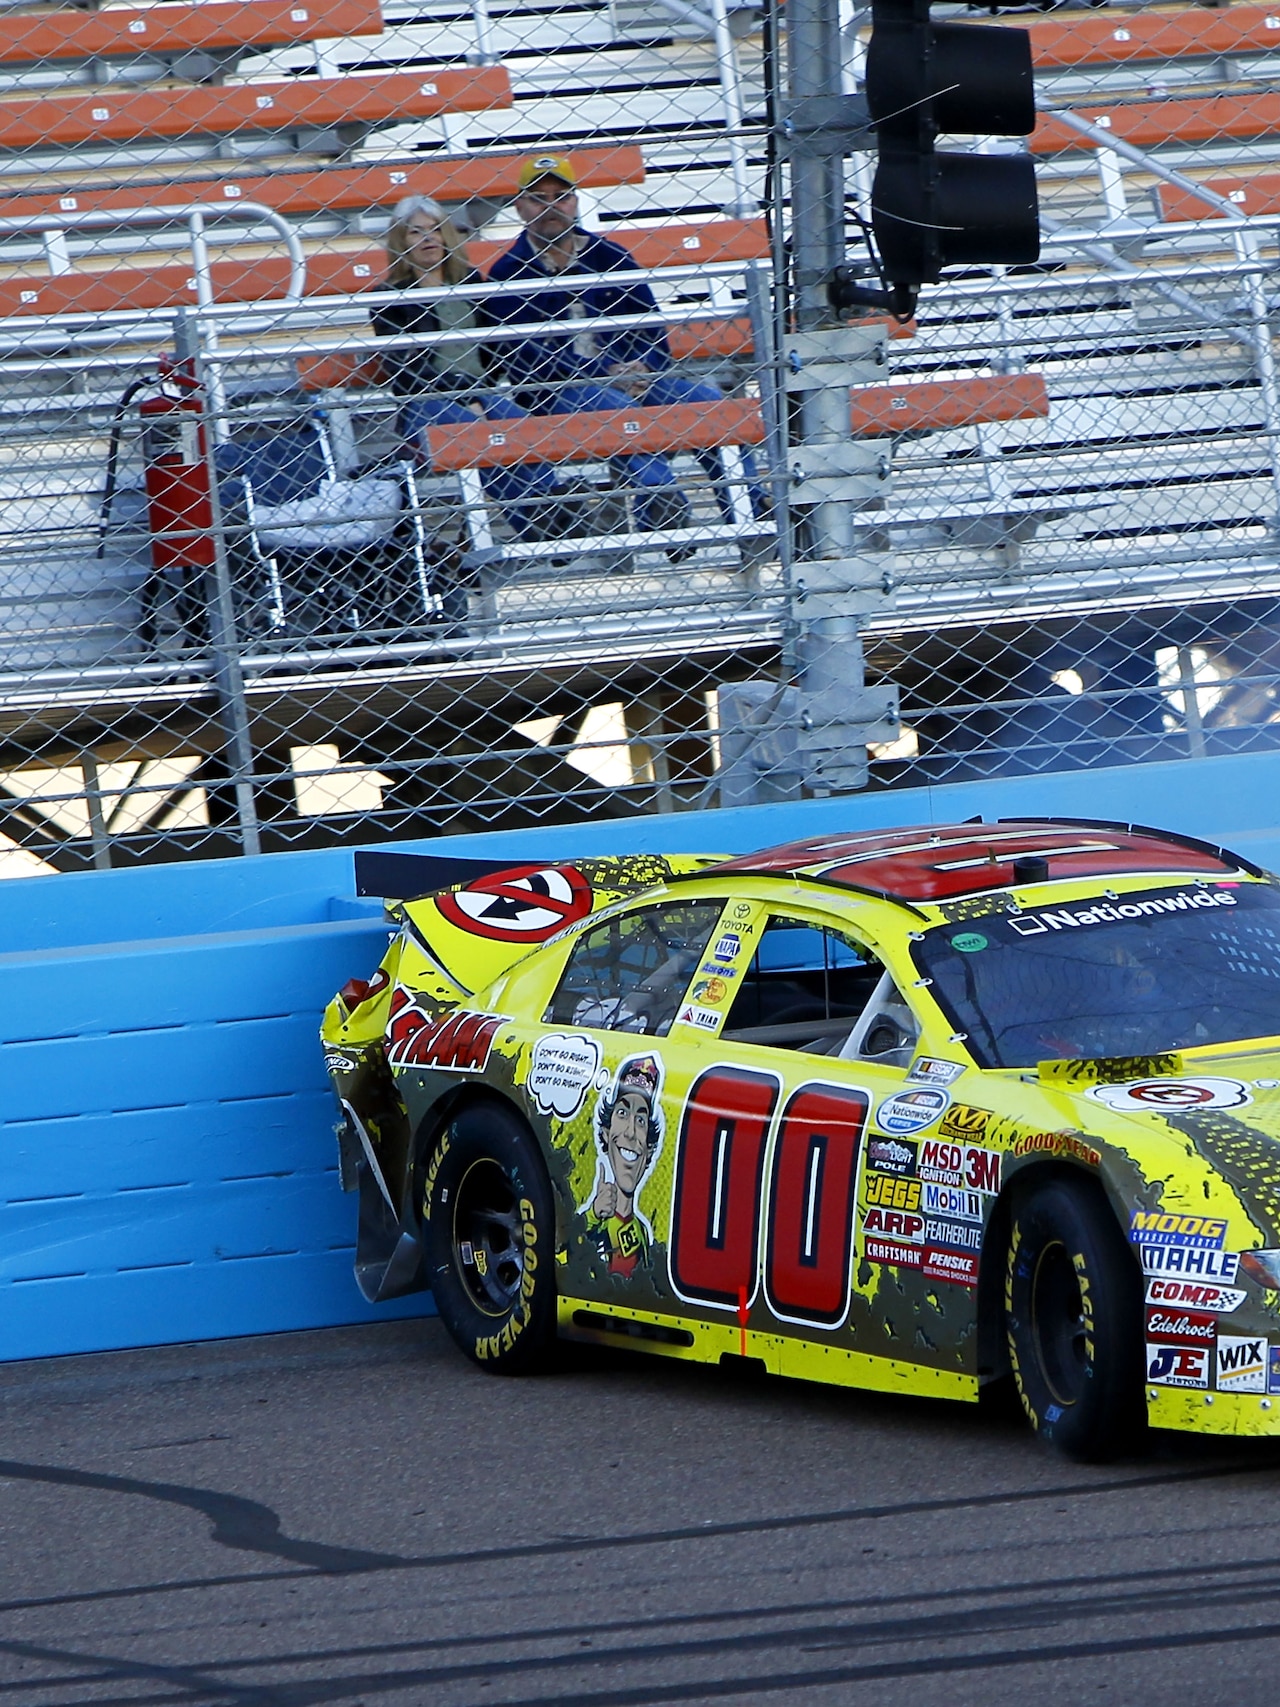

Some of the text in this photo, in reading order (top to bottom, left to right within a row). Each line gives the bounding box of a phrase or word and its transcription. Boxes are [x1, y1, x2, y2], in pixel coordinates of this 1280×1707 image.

[1041, 890, 1238, 930] Nationwide
[721, 919, 754, 935] TOYOTA
[696, 1011, 719, 1027] TRIAD
[537, 1062, 555, 1072] DON'T
[556, 1064, 565, 1073] GO
[540, 1048, 558, 1058] DON'T
[560, 1051, 569, 1059] GO
[535, 1076, 552, 1085] DON'T
[553, 1077, 561, 1086] GO
[890, 1104, 933, 1121] Nationwide
[890, 1150, 914, 1164] LIGHT
[920, 1141, 962, 1170] MSD
[1013, 1133, 1102, 1167] GOODYEAR
[422, 1131, 450, 1221] EAGLE
[874, 1160, 907, 1173] POLE
[919, 1166, 960, 1187] IGNITION
[965, 1149, 1000, 1193] 3M
[668, 1062, 875, 1330] 00
[866, 1174, 922, 1211] JEGS
[926, 1184, 965, 1213] Mobil
[968, 1194, 981, 1216] 1
[862, 1208, 923, 1238] ARP
[925, 1219, 982, 1250] FEATHERLITE
[1131, 1211, 1227, 1239] MOOG
[866, 1242, 922, 1266] CRAFTSMAN
[1182, 1236, 1218, 1249] PARTS
[928, 1251, 974, 1272] PENSKE
[1142, 1244, 1239, 1277] MAHLE
[475, 1198, 538, 1360] GOODYEAR
[1150, 1280, 1220, 1303] COMP
[1072, 1252, 1095, 1362] EAGLE
[1147, 1313, 1216, 1339] Edelbrock
[1148, 1348, 1206, 1379] JE
[1218, 1340, 1264, 1372] WIX
[1165, 1375, 1208, 1389] PISTONS
